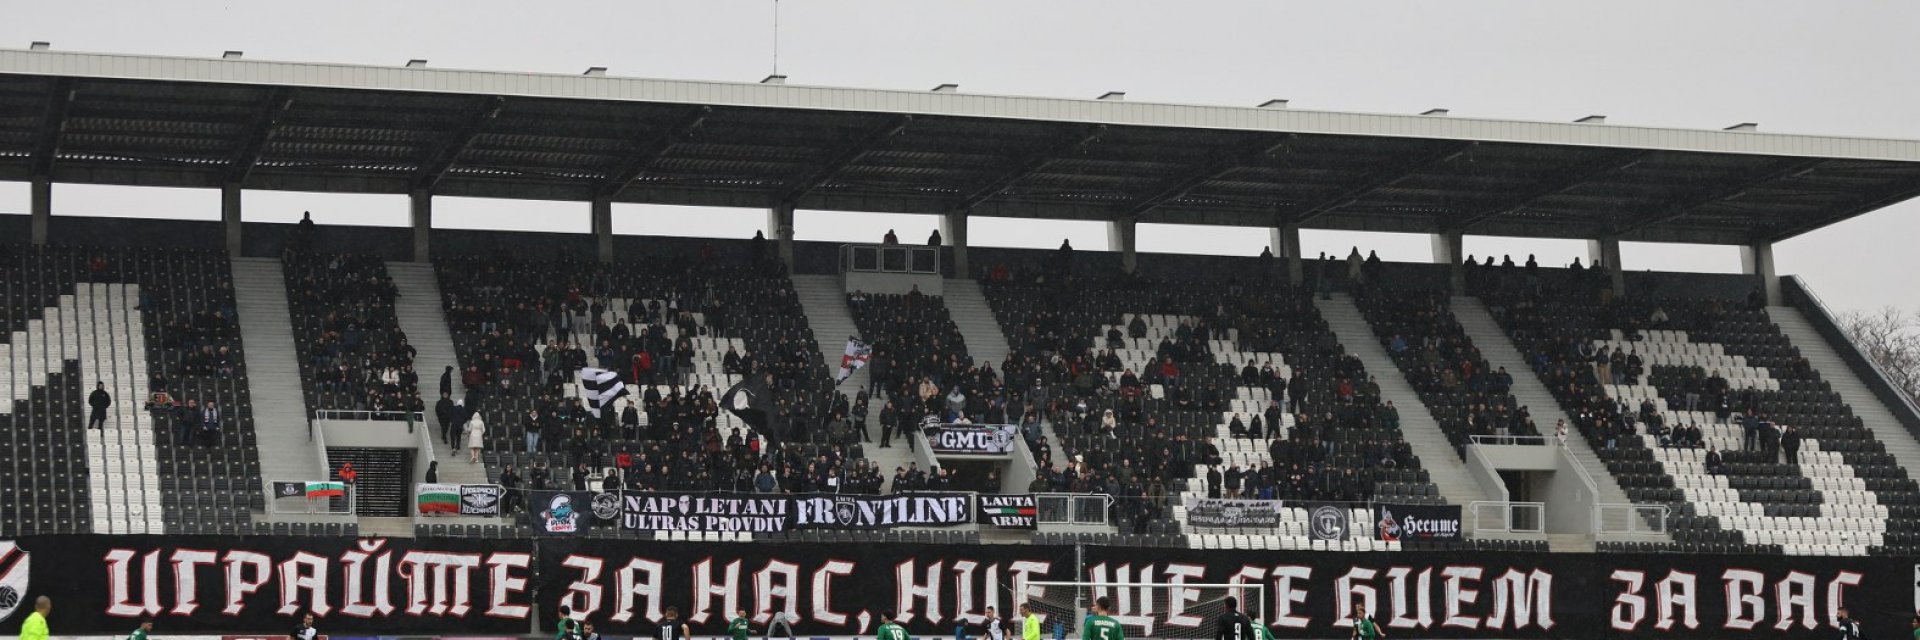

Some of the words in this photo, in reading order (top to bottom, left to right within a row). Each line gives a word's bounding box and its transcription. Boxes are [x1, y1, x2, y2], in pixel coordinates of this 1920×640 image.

[941, 430, 989, 448] GMU
[982, 496, 1034, 507] LAUTA
[624, 513, 700, 530] ULTRAS
[991, 516, 1033, 526] ARMY
[104, 539, 531, 618] ИГРАЙТЕ
[560, 555, 664, 624] ЗА
[690, 556, 870, 633] НАС,
[1334, 566, 1555, 630] БИЕМ
[1610, 568, 1699, 631] ЗА
[1722, 568, 1865, 631] ВАС
[662, 625, 673, 640] 10
